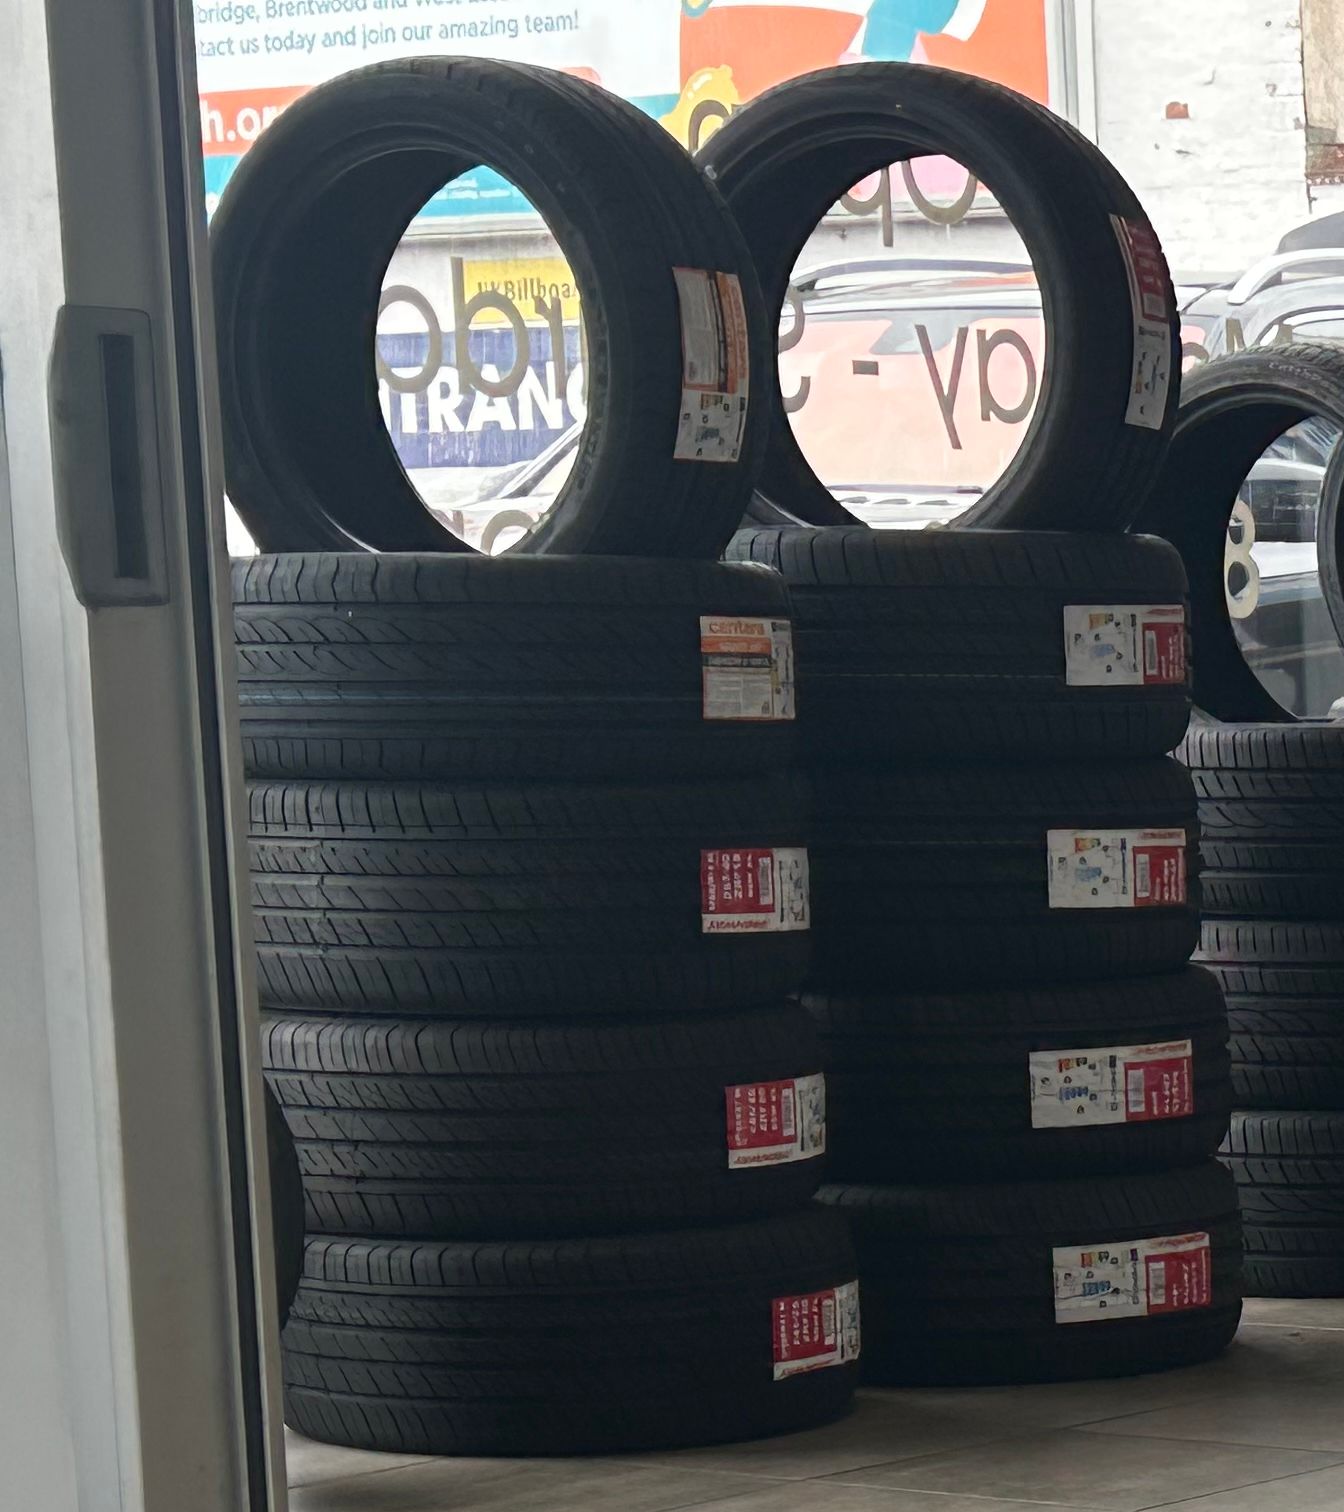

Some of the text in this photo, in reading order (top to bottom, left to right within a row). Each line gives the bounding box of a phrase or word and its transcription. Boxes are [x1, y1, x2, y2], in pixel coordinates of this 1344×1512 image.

[197, 2, 260, 25] bridge,
[240, 37, 259, 54] us
[264, 30, 316, 55] today
[321, 25, 356, 47] and
[362, 21, 396, 50] join
[402, 25, 433, 41] our
[438, 15, 518, 39] amazing
[525, 9, 579, 34] team!
